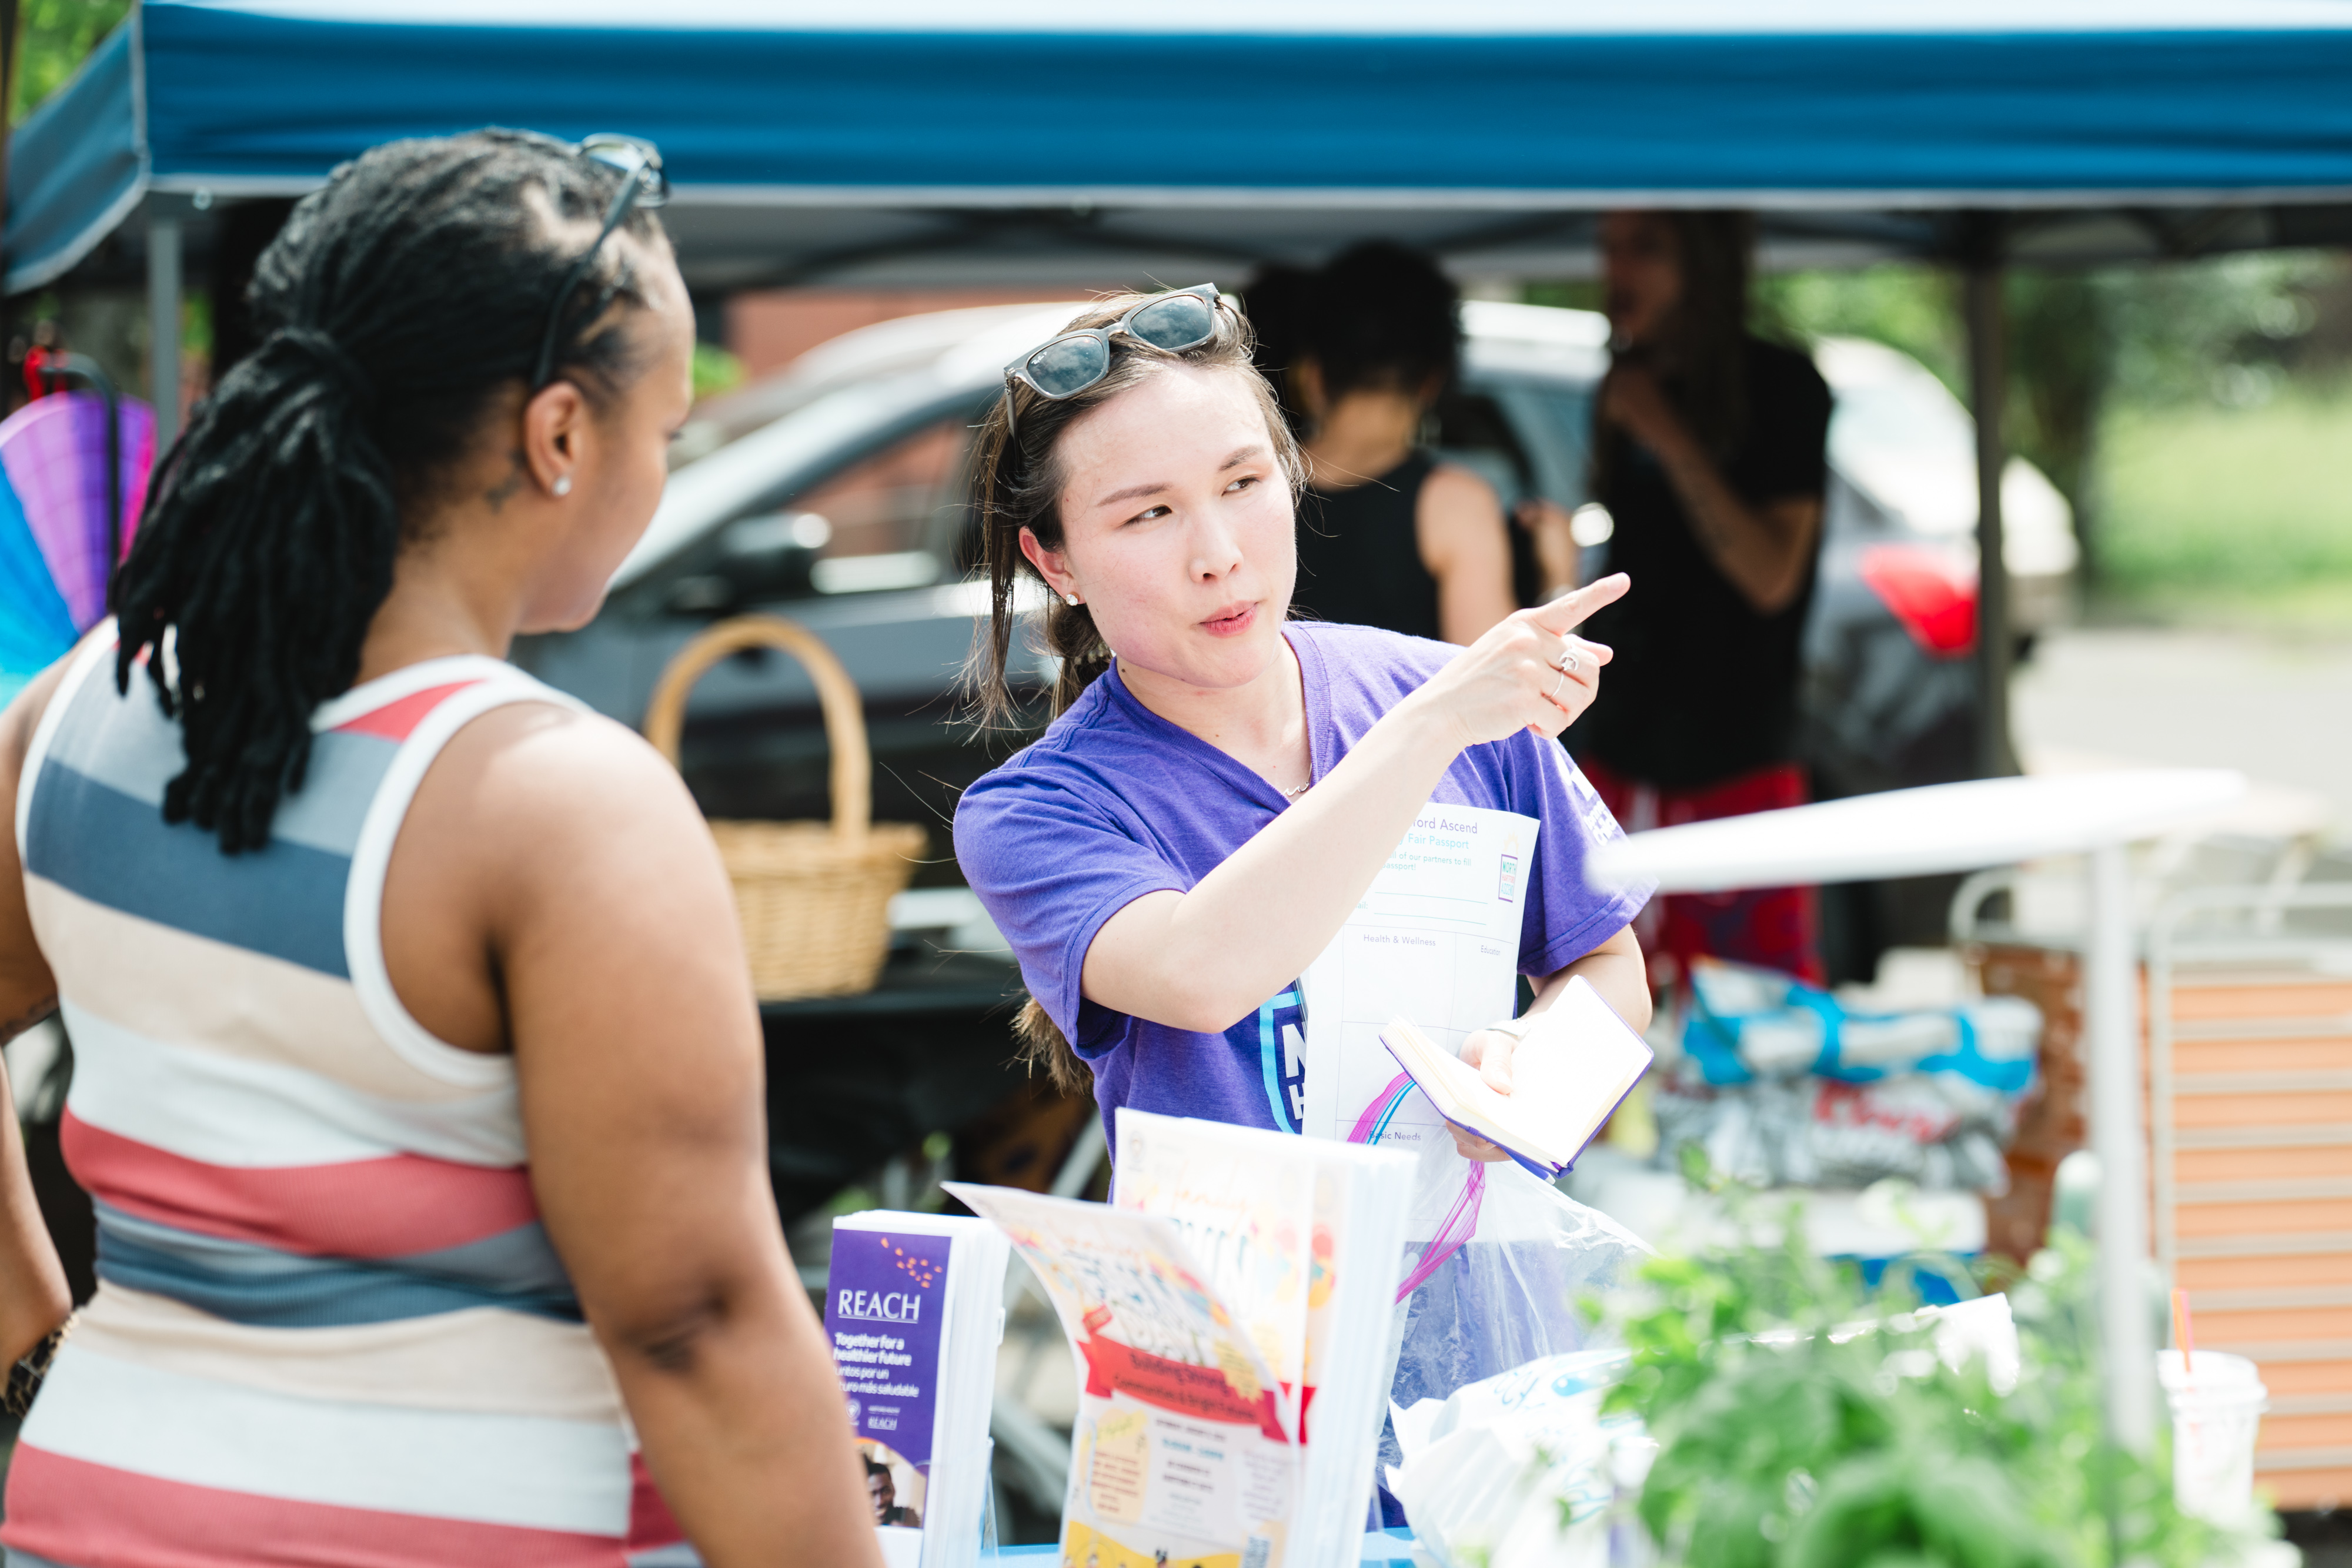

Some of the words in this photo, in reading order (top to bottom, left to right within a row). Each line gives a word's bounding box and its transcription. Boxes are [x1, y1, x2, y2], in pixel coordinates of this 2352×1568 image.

[1440, 818, 1478, 834] Ascend
[1408, 833, 1426, 845] Fair
[1429, 835, 1469, 850] Passport
[1399, 851, 1407, 860] of
[1423, 855, 1452, 865] partners
[1464, 858, 1472, 867] fill
[1502, 861, 1516, 875] NORTH
[1363, 934, 1391, 944] Health
[1393, 935, 1399, 944] &
[1402, 936, 1436, 947] Wellness
[1481, 945, 1501, 956] Education
[1394, 1131, 1422, 1141] Needs
[838, 1289, 921, 1321] REACH
[834, 1332, 879, 1349] Together
[879, 1334, 896, 1350] for
[896, 1338, 905, 1350] a
[833, 1346, 877, 1364] healthier
[878, 1349, 912, 1366] future
[876, 1368, 890, 1380] un
[877, 1382, 920, 1398] saludable
